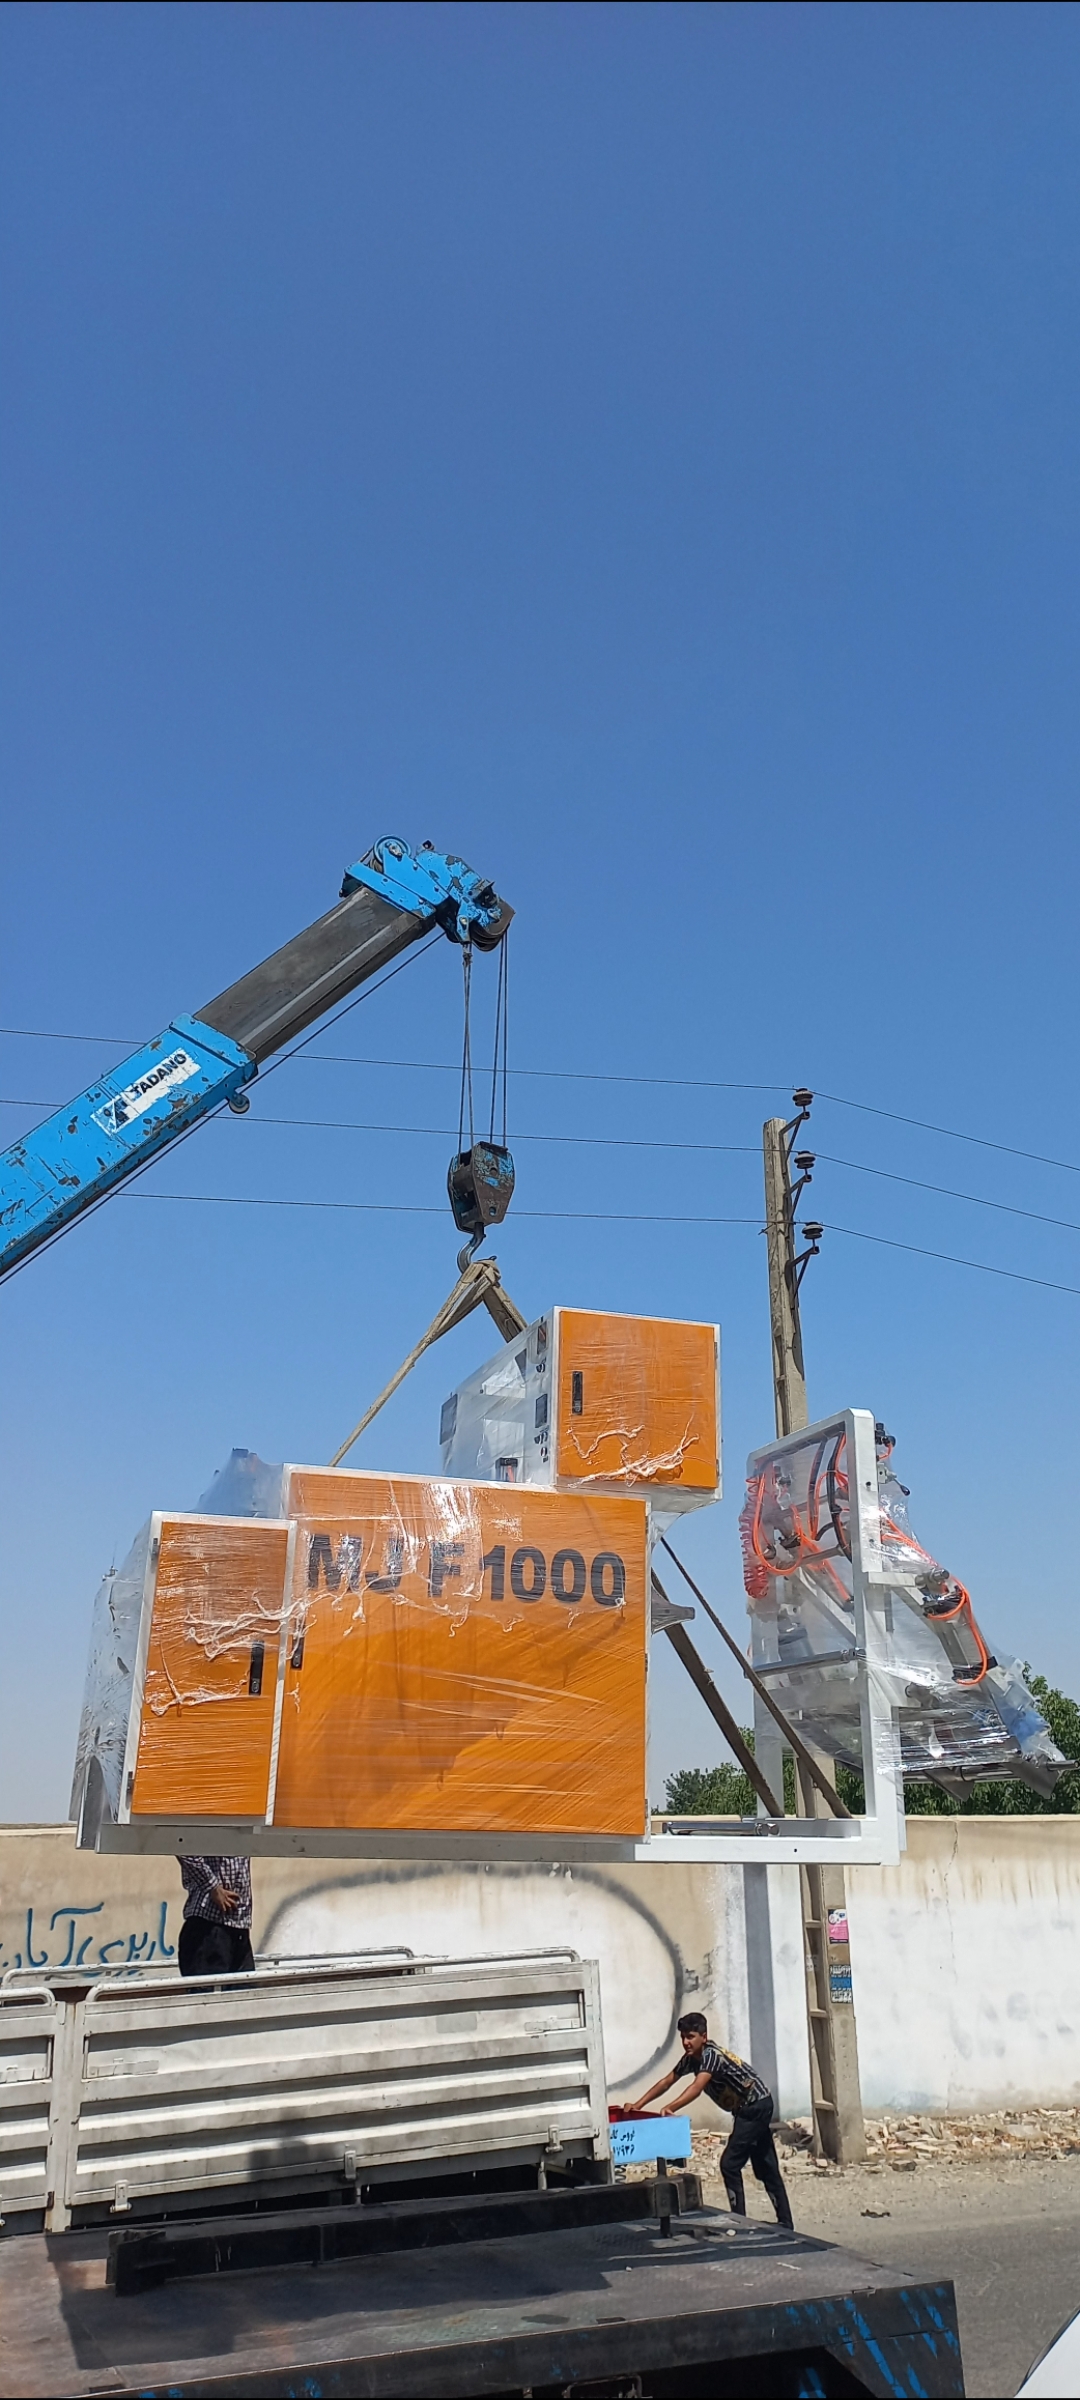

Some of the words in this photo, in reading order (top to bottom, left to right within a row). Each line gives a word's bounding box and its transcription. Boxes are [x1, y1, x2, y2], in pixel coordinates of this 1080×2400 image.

[130, 1053, 187, 1098] TADANO
[306, 1533, 405, 1594] MJ
[427, 1540, 466, 1598] F
[481, 1544, 627, 1607] 1000
